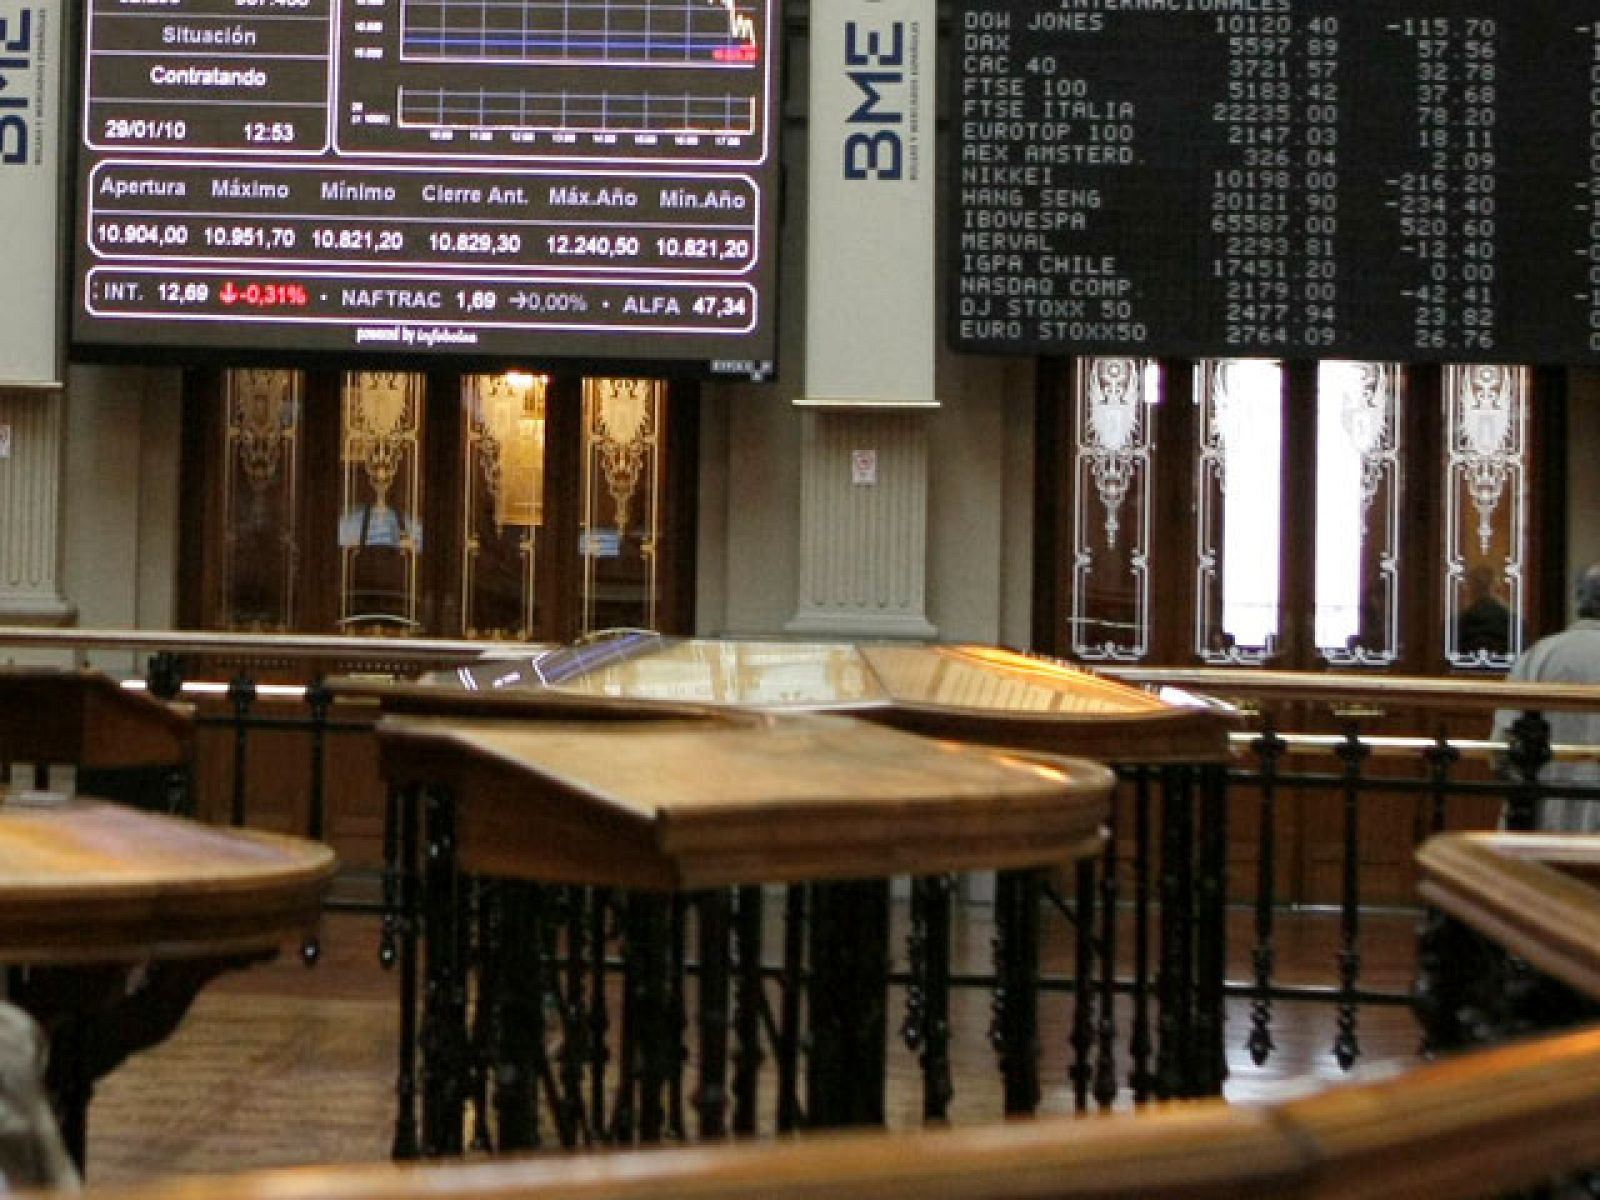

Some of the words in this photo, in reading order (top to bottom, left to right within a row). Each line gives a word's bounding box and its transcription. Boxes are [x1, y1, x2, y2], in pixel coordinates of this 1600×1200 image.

[163, 25, 255, 45] Situación
[964, 12, 1010, 30] DOW
[1027, 13, 1105, 31] JONES
[1215, 15, 1338, 35] 10120.40
[1385, 19, 1495, 37] -115.70
[964, 34, 1010, 52] DAX
[1230, 36, 1338, 56] 5597.89
[1416, 40, 1495, 58] 57.56
[150, 65, 265, 85] Contratando
[964, 56, 1010, 74] CAC
[1025, 57, 1056, 75] 40
[1230, 59, 1338, 79] 3721.57
[1416, 62, 1495, 80] 32.78
[845, 21, 903, 181] BME
[963, 78, 1025, 96] FTSE
[1043, 79, 1088, 97] 100
[1229, 81, 1337, 101] 5183.42
[1416, 85, 1495, 103] 37.68
[963, 100, 1025, 118] FTSE
[1043, 101, 1136, 119] ITALIA
[1214, 102, 1337, 122] 22235.00
[1416, 107, 1495, 125] 78.20
[105, 120, 185, 140] 29/01/10
[245, 123, 293, 142] 12:53
[962, 123, 1071, 141] EUROTOP
[1089, 124, 1134, 142] 100
[1229, 125, 1337, 145] 2147.03
[1416, 130, 1495, 148] 18.11
[962, 144, 1009, 162] AEX
[1244, 147, 1337, 167] 326.04
[1431, 151, 1495, 169] 2.09
[100, 177, 185, 198] Apertura
[212, 178, 290, 198] Máximo
[322, 180, 395, 200] Mínimo
[422, 185, 482, 203] Cierre
[487, 187, 528, 203] Ant.
[962, 167, 1051, 185] NIKKEI
[1214, 168, 1337, 188] 10198.00
[1385, 173, 1495, 191] -216.20
[961, 189, 1023, 207] HANG
[1039, 190, 1101, 208] SENG
[1213, 191, 1336, 211] 20121.90
[1384, 196, 1494, 214] -234.40
[963, 212, 1086, 230] IBOVESPA
[1213, 213, 1336, 233] 65587.00
[1400, 218, 1494, 236] 520.60
[98, 225, 188, 245] 10.904,00
[205, 227, 295, 248] 10.951,70
[313, 230, 403, 252] 10.821,20
[430, 233, 520, 255] 10.829,30
[548, 235, 640, 257] 12.240,50
[657, 238, 750, 260] 10.821,20
[961, 233, 1053, 251] MERVAL
[1228, 236, 1336, 256] 2293.81
[1399, 240, 1494, 258] -12.40
[963, 255, 1023, 273] IGPA
[1039, 256, 1117, 274] CHILE
[1213, 258, 1336, 278] 17451.20
[1430, 262, 1494, 280] 0.00
[105, 283, 142, 300] INT.
[239, 283, 308, 307] -0,31%
[342, 290, 440, 308] NAFTRAC
[525, 293, 587, 310] 0,00%
[623, 297, 680, 315] ALFA
[692, 295, 745, 318] 47,34
[960, 277, 1053, 295] NASDAQ
[1228, 281, 1336, 301] 2179.00
[1399, 285, 1494, 303] -42.41
[960, 298, 991, 316] DJ
[1007, 299, 1085, 317] STOXX
[1100, 300, 1131, 318] 50
[1227, 303, 1335, 323] 2477.94
[1415, 307, 1494, 325] 23.82
[960, 319, 1021, 337] EURO
[1038, 321, 1146, 339] STOXX50
[1227, 324, 1335, 344] 2764.09
[1415, 329, 1494, 347] 26.76
